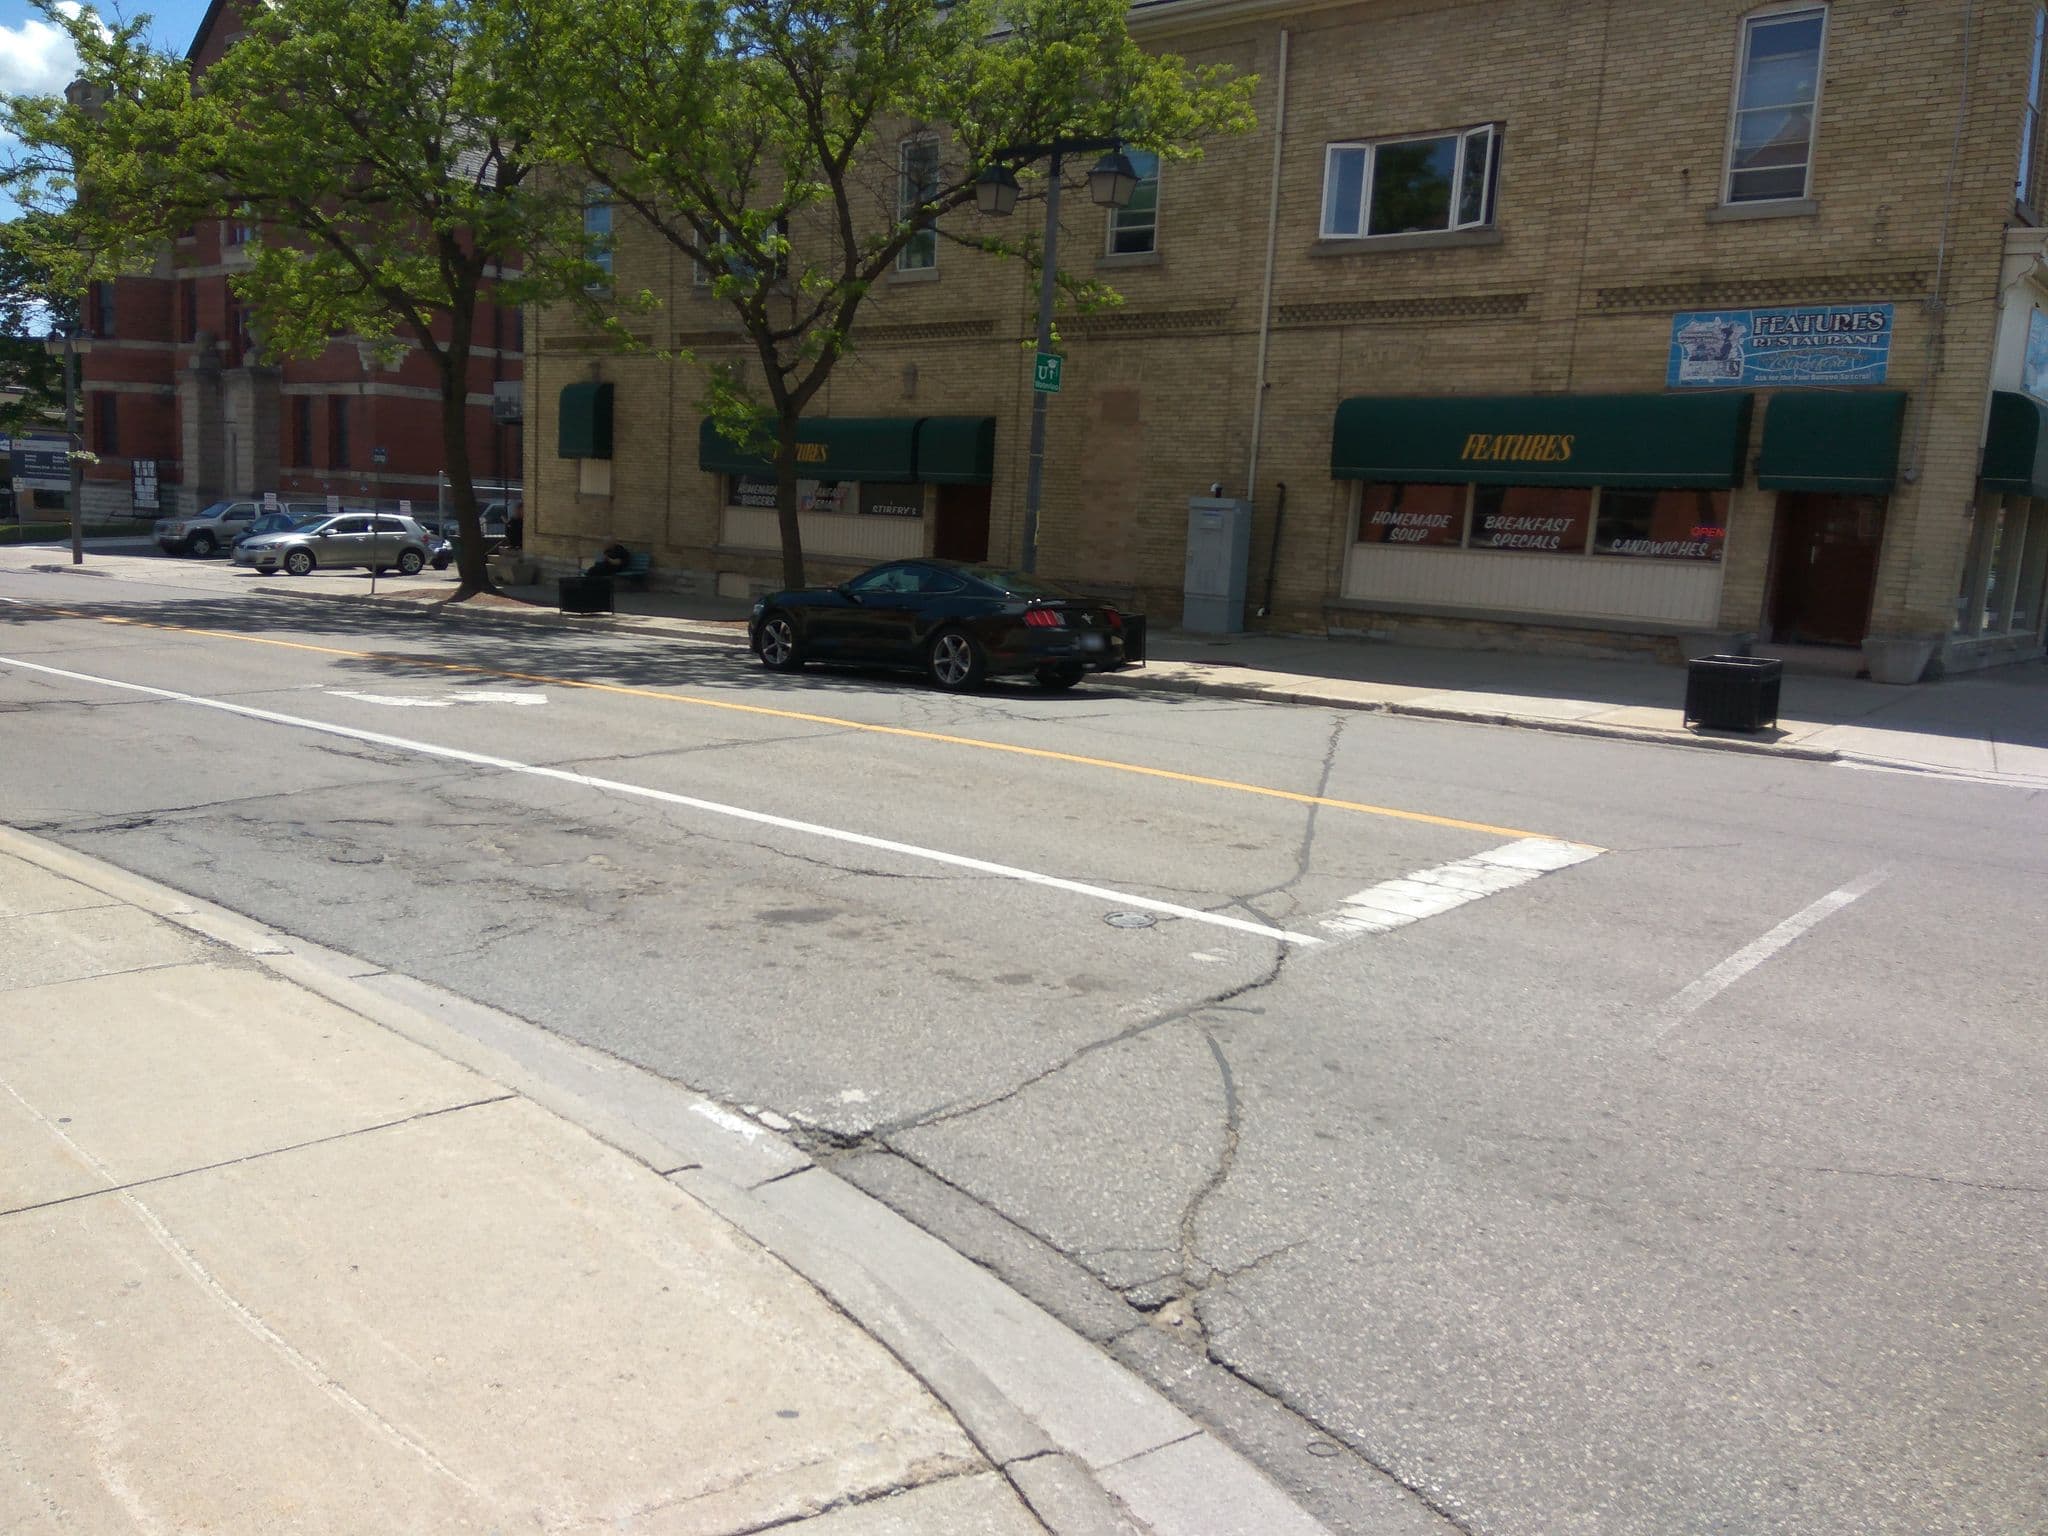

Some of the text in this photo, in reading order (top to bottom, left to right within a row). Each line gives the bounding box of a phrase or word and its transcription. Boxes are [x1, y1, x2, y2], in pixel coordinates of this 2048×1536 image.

[1753, 312, 1885, 335] FEATURES
[1752, 334, 1881, 347] RESTAURANT
[1461, 433, 1575, 463] FEATURES
[1371, 511, 1453, 529] HOMEMADE
[1483, 515, 1575, 534] BREAKFAST
[1389, 528, 1429, 543] SOUP
[1691, 527, 1725, 537] OPEN
[1491, 533, 1560, 550] SPECIALS
[1610, 538, 1709, 557] SANDWICHES
